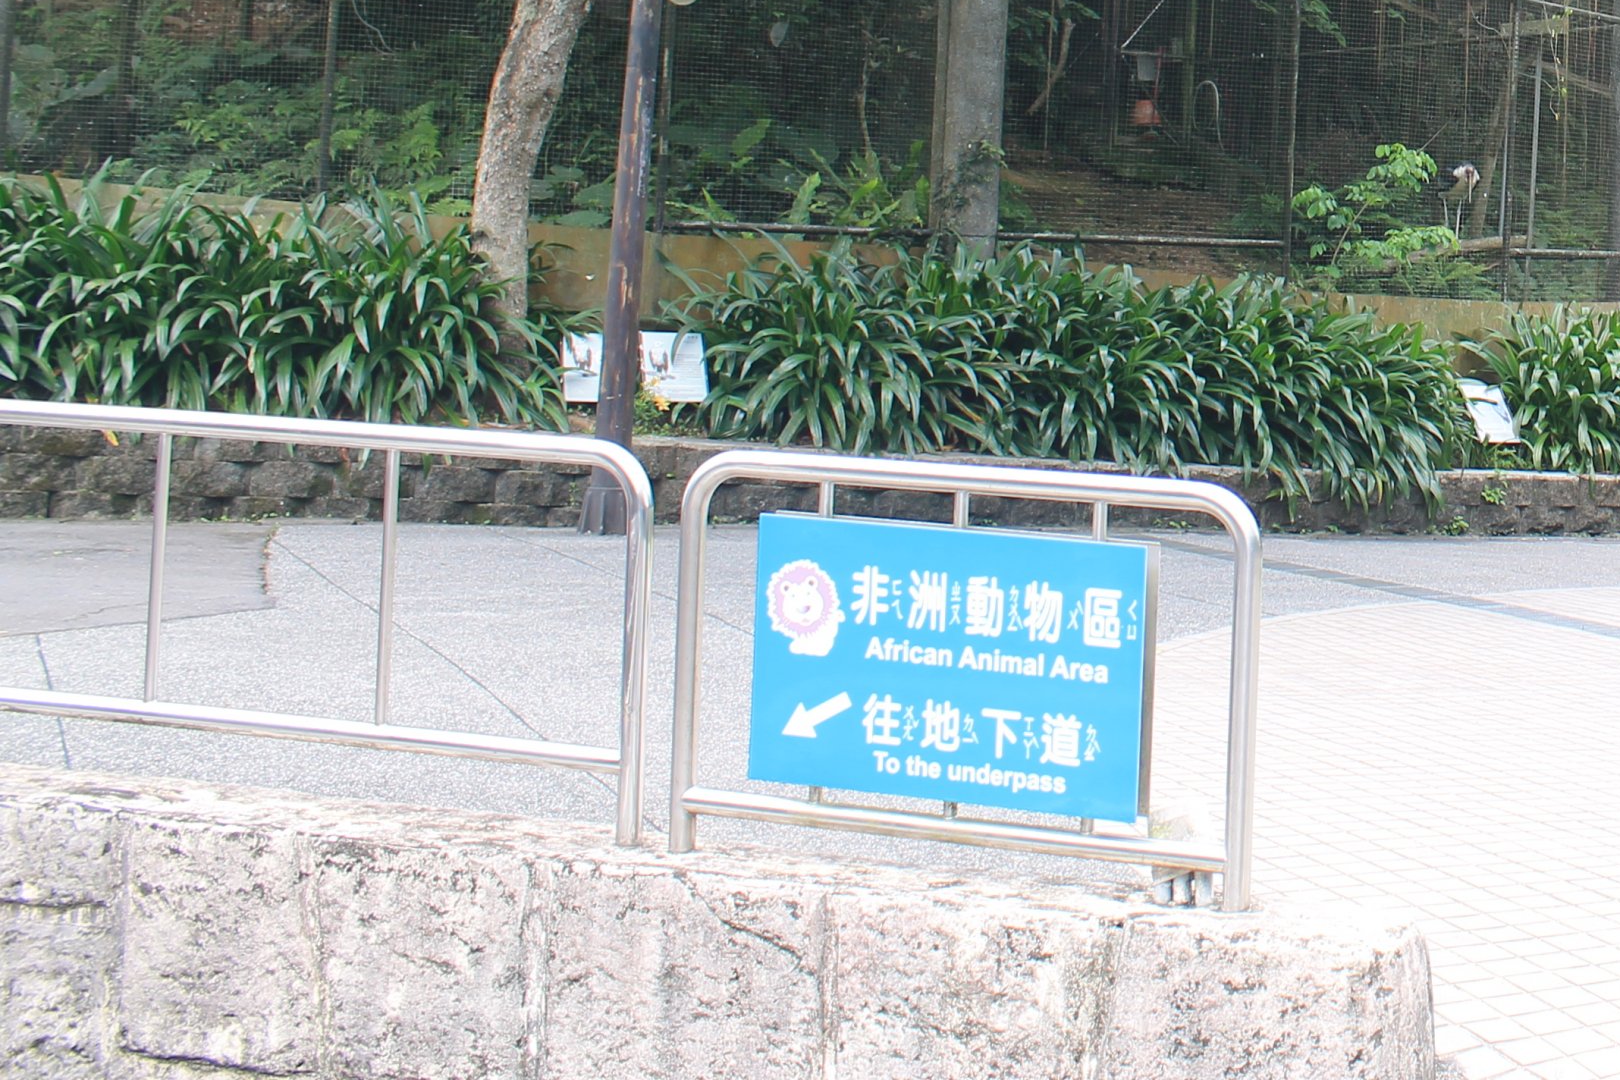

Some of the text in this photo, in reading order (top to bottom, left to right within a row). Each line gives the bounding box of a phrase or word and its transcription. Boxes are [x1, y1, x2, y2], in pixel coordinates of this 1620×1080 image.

[850, 565, 1122, 649] 非洲動物區
[865, 636, 1109, 684] African Animal Area
[862, 693, 1082, 767] 往地下道
[873, 750, 1067, 794] To the underpass
